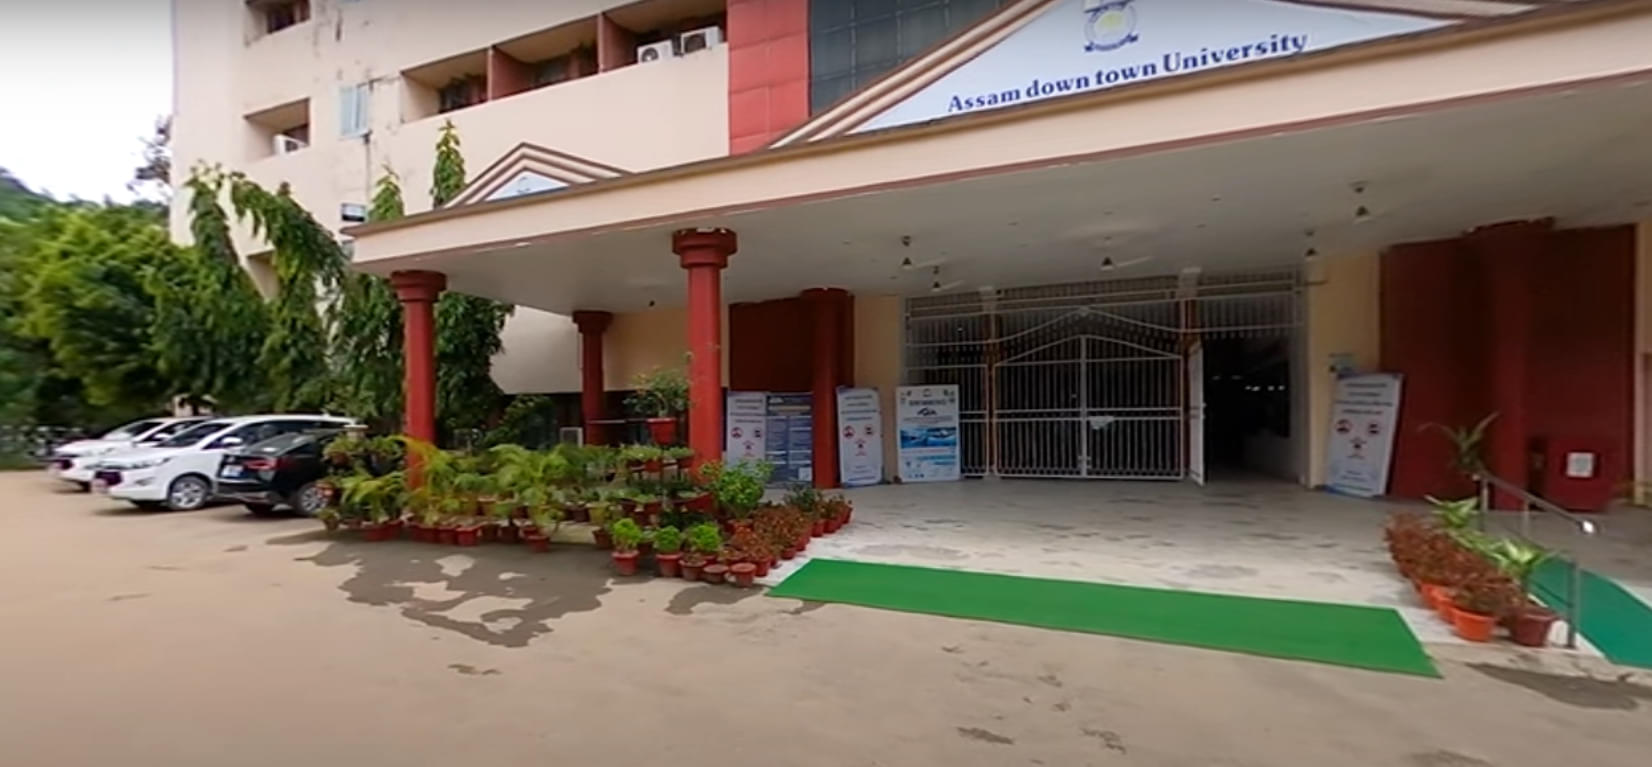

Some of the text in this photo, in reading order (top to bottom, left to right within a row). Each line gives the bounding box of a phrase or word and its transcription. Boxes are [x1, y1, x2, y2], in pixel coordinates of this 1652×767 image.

[948, 88, 1021, 112] Assam
[1026, 75, 1090, 98] down
[1095, 63, 1157, 86] town
[1163, 34, 1308, 72] University
